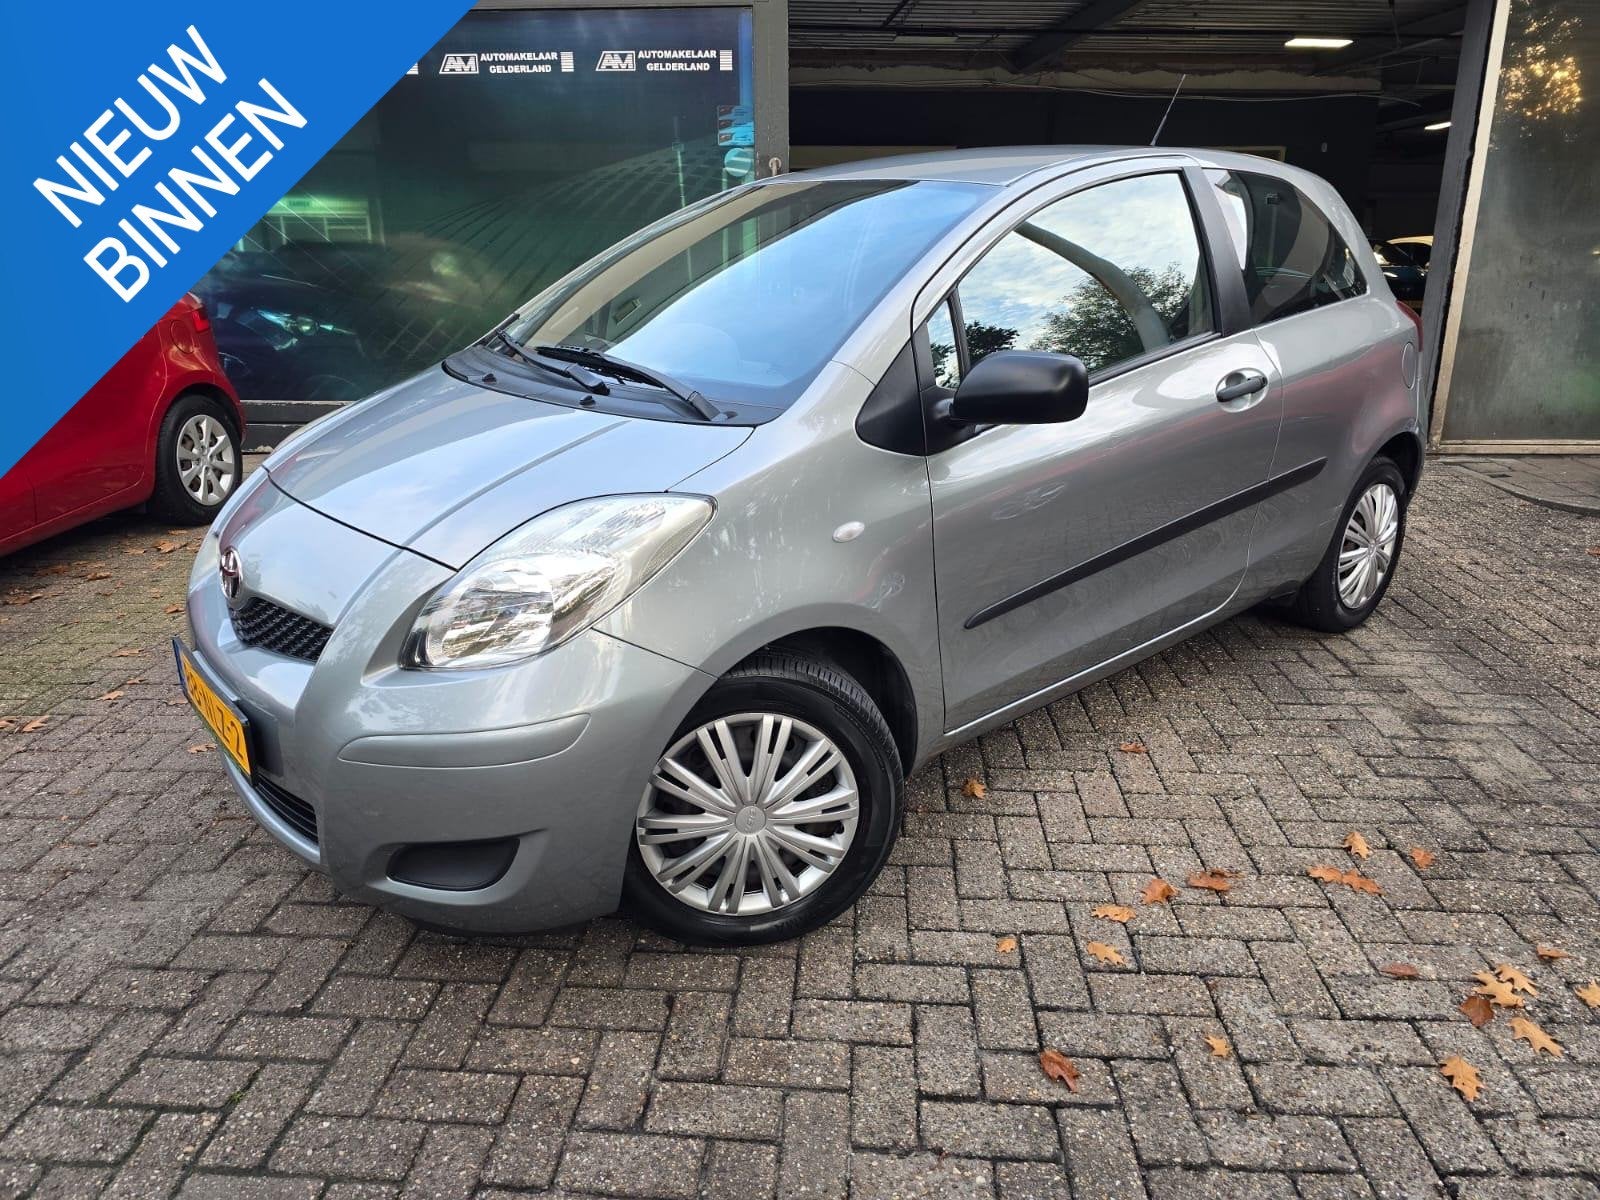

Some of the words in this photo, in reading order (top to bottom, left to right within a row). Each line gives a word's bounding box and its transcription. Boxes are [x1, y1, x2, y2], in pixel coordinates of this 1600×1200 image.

[480, 52, 558, 62] AUTOMAKELAAR
[638, 50, 717, 59] AUTOMAKELAAR
[489, 64, 551, 74] GELDERLAND
[647, 62, 710, 71] GELDERLAND
